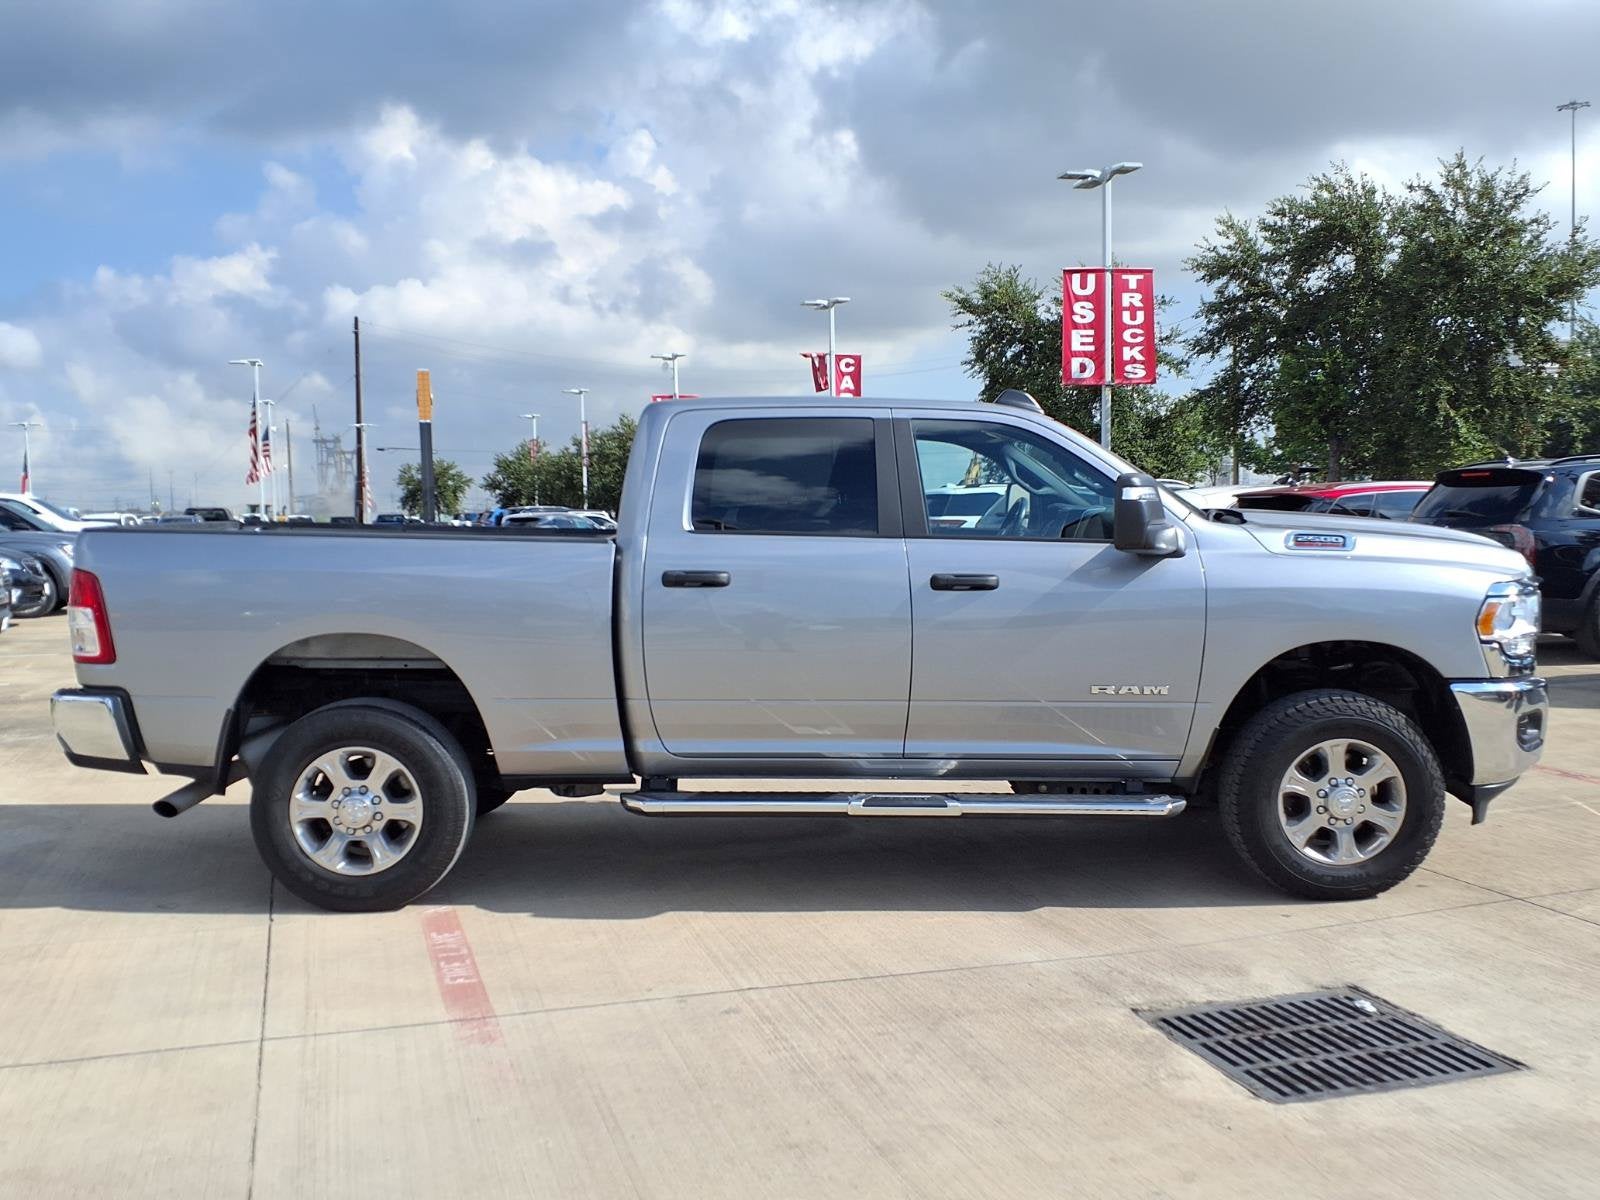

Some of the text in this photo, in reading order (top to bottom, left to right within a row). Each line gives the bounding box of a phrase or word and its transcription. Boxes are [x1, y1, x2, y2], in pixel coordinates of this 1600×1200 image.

[1071, 273, 1096, 379] USED
[1121, 274, 1147, 379] TRUCKS
[839, 358, 855, 397] CA
[1091, 685, 1169, 695] RAM
